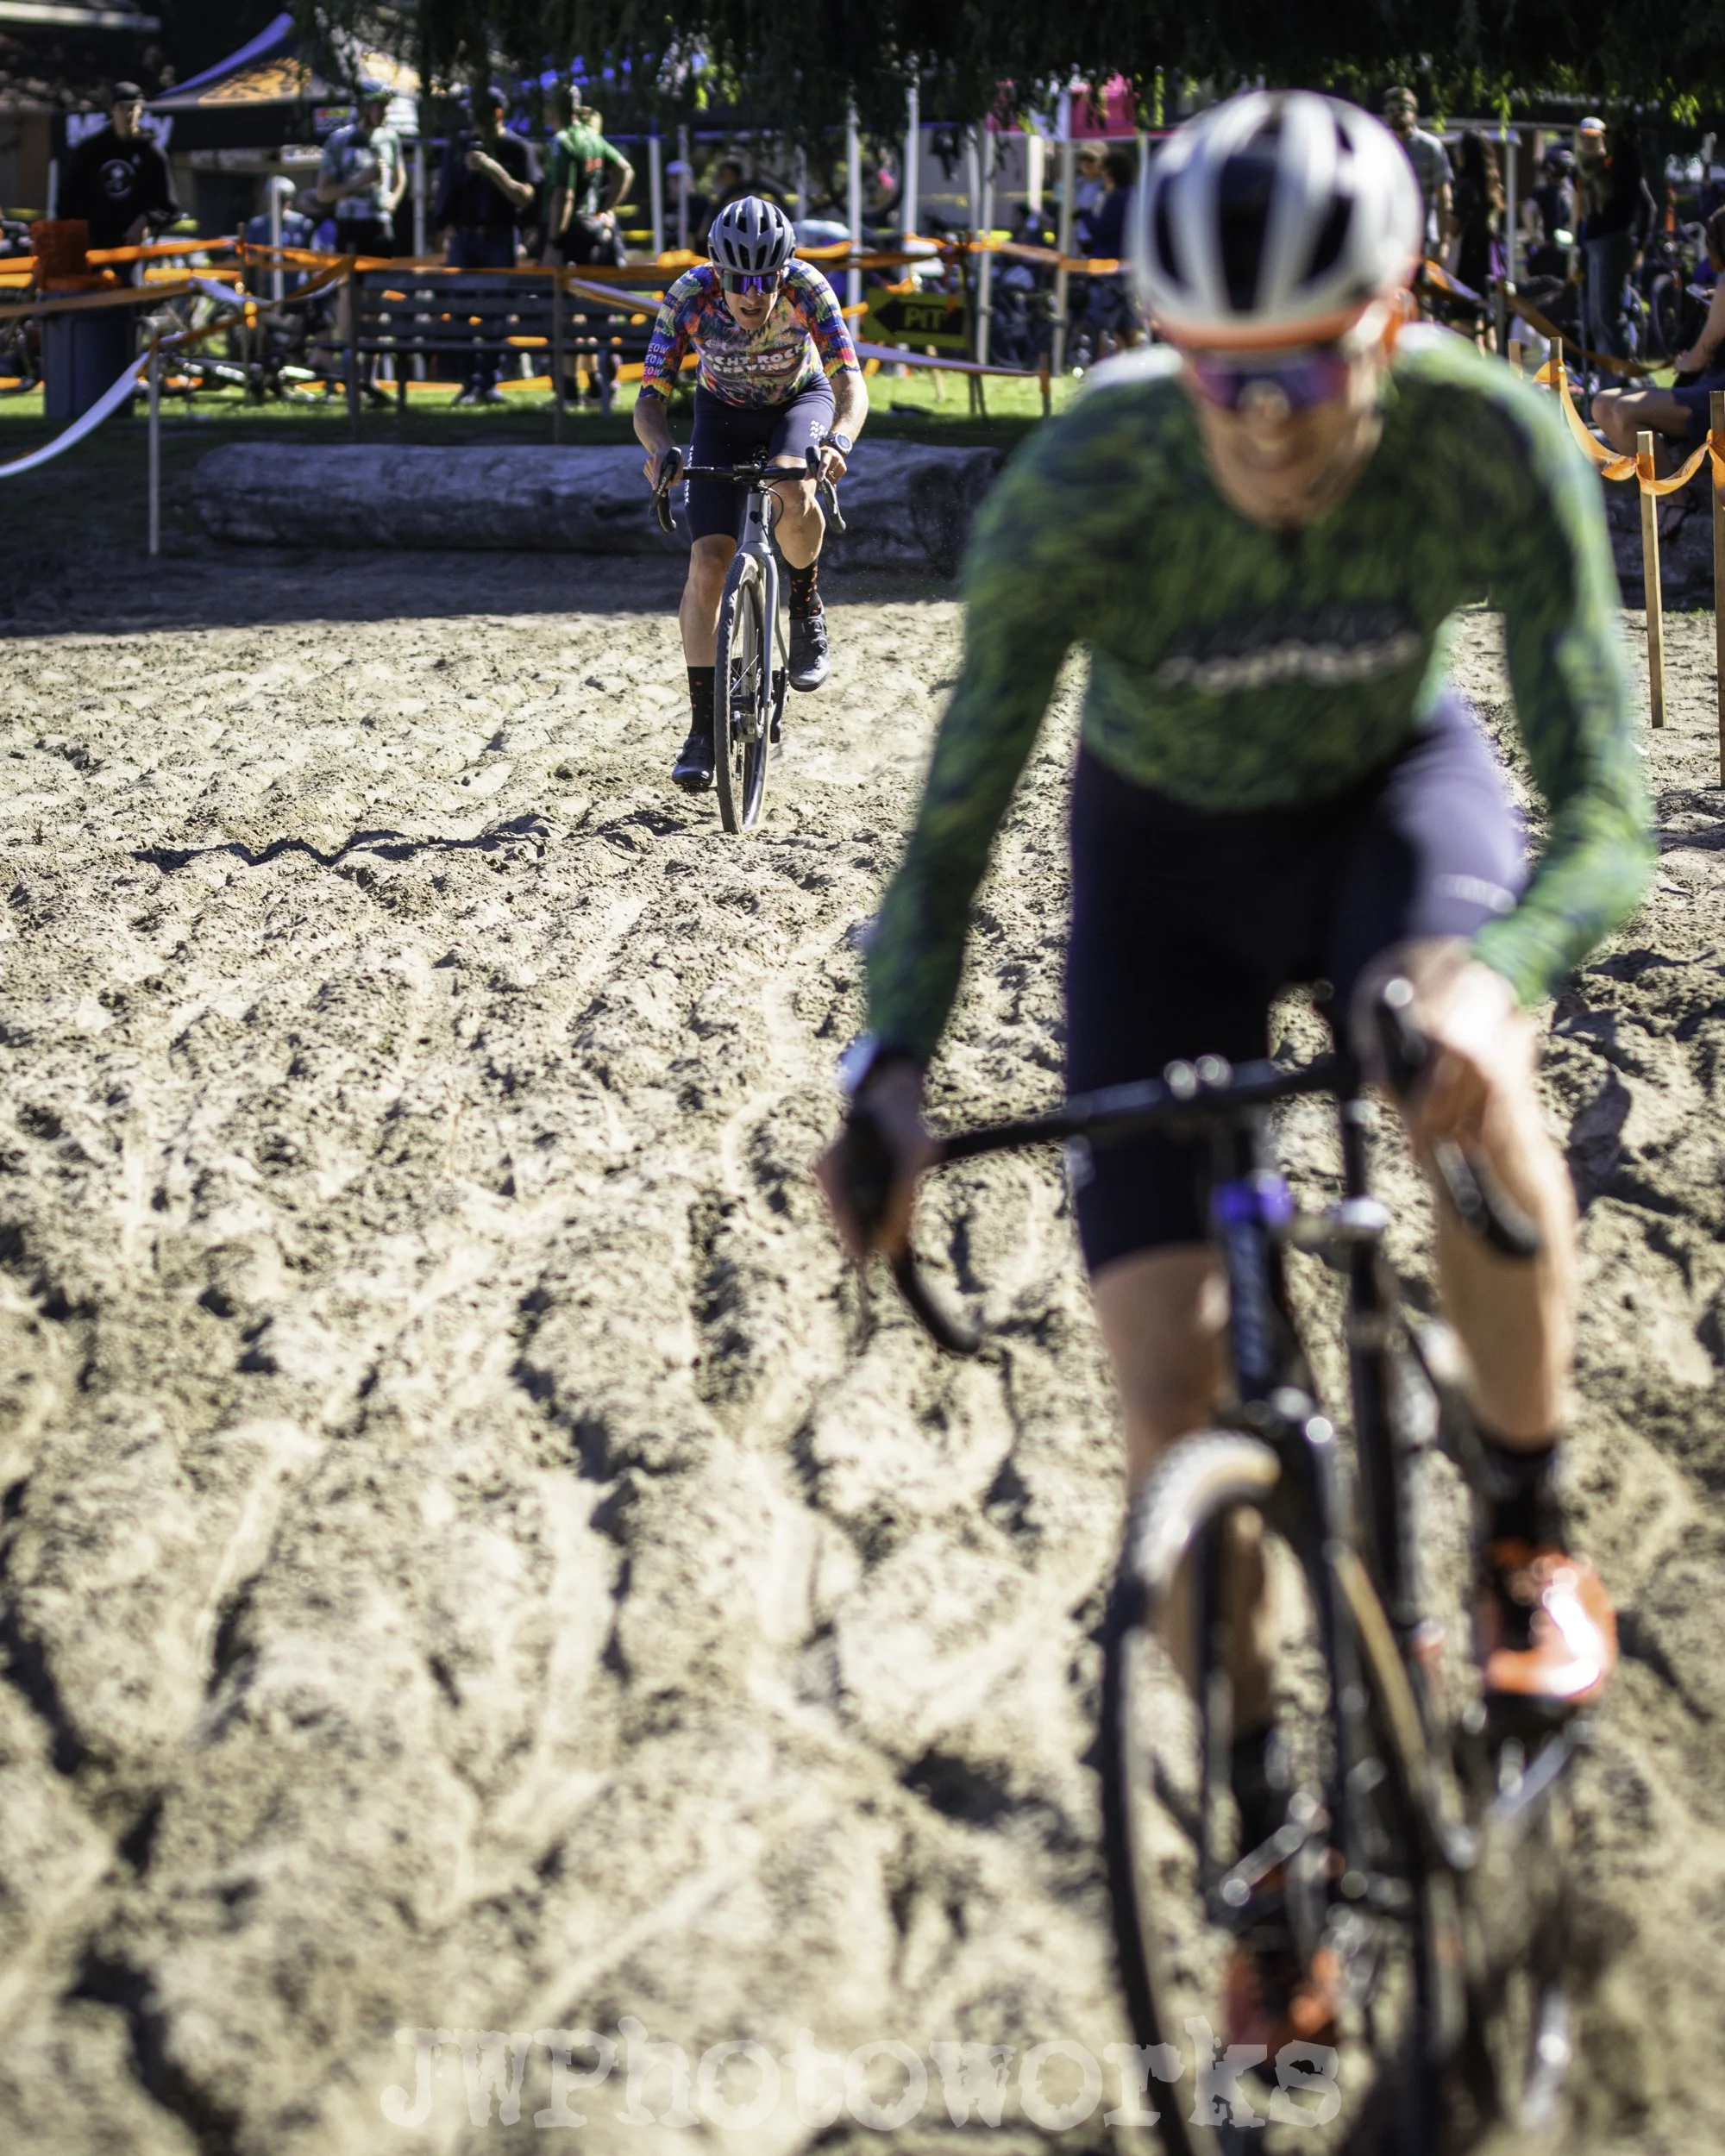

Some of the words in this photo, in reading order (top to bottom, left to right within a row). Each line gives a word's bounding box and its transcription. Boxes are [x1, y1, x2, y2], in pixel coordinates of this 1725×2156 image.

[903, 306, 950, 330] PIT
[648, 342, 669, 354] EOW
[757, 342, 806, 363] ROCK
[644, 354, 666, 365] EOW
[643, 366, 663, 377] EOW
